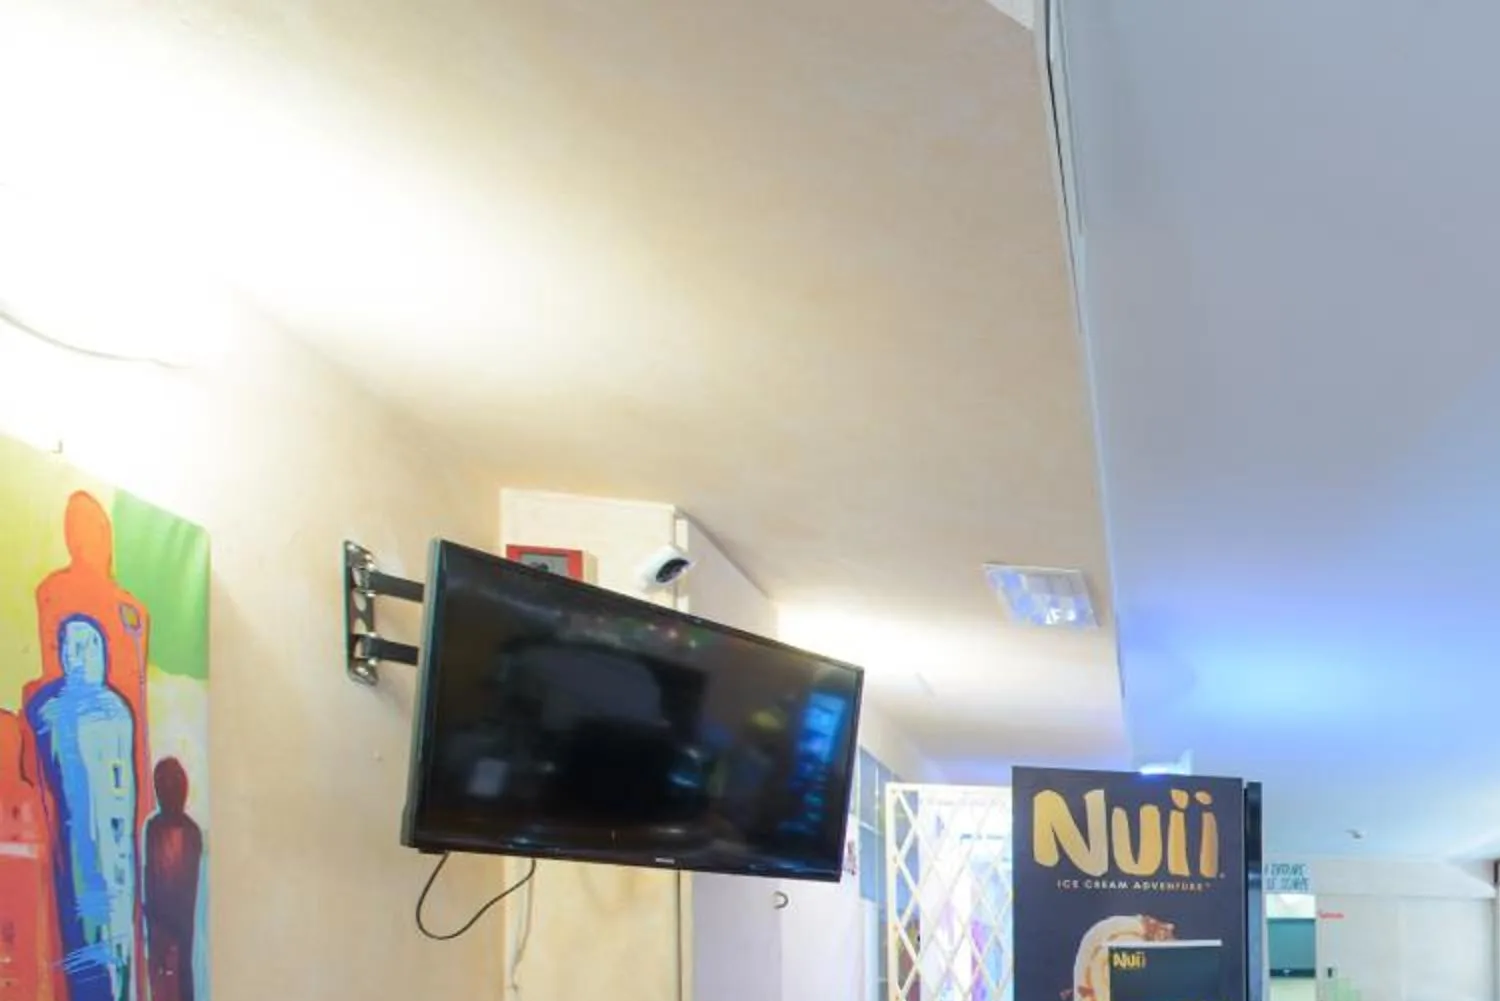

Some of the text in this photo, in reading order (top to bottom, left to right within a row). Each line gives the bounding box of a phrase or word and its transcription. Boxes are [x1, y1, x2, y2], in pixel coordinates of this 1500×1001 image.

[1033, 789, 1219, 878] Nuii
[1056, 879, 1080, 889] ICE
[1084, 879, 1129, 890] CREAM
[1113, 951, 1146, 969] Nuii
